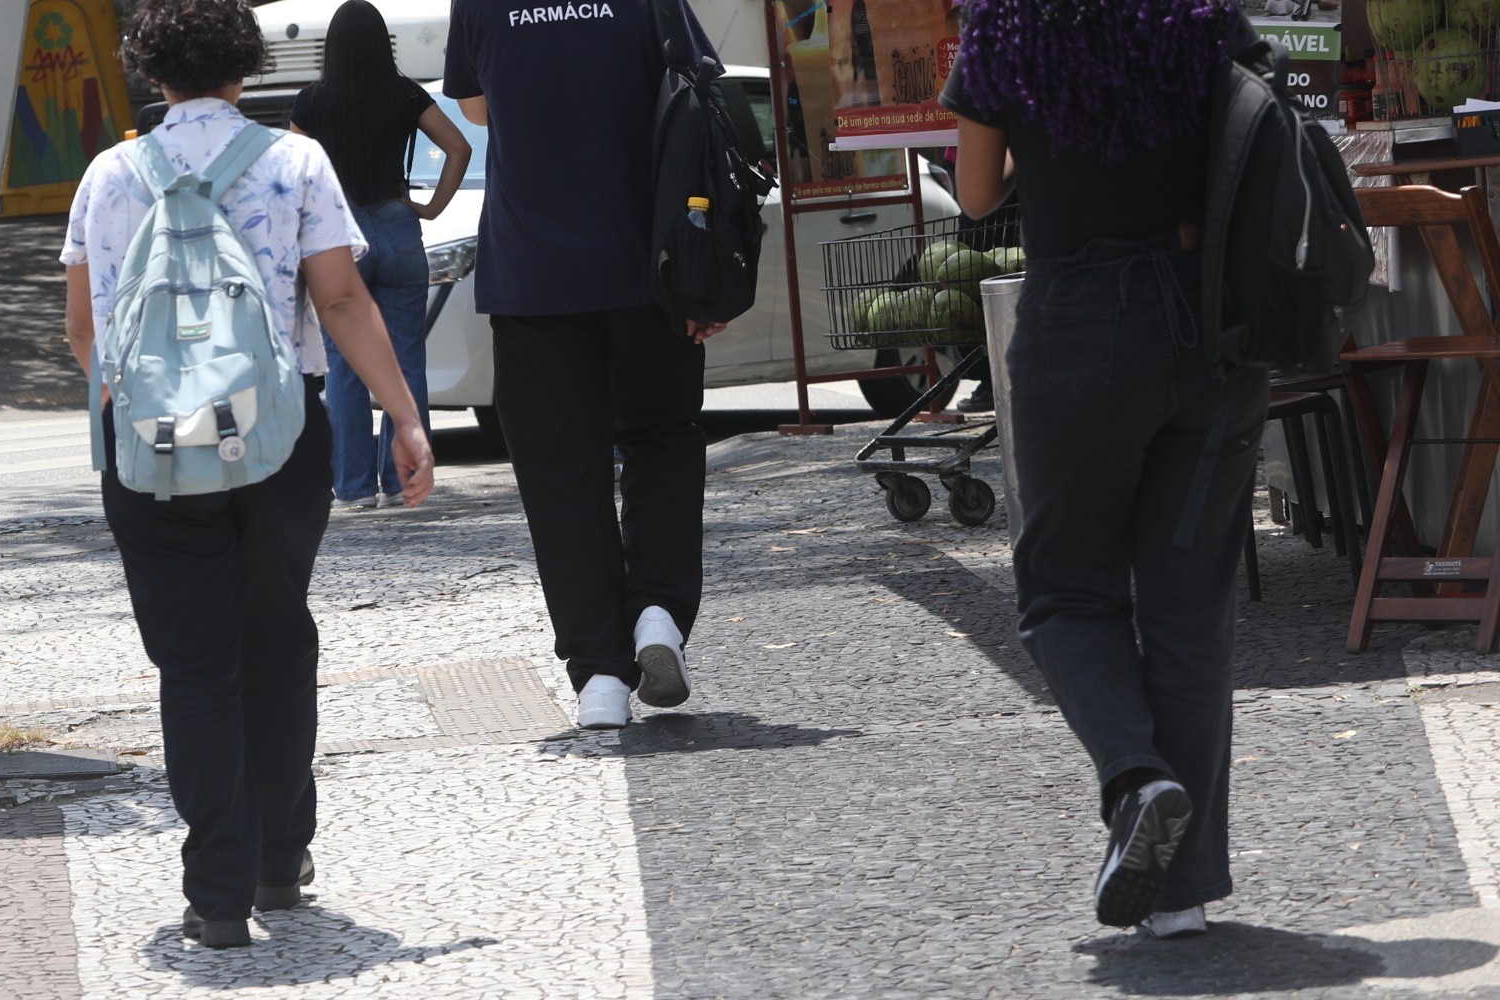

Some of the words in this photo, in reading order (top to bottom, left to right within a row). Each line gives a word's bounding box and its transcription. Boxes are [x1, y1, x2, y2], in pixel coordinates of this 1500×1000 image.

[508, 2, 614, 27] FARMÁCIA
[838, 116, 848, 128] Dê
[850, 116, 862, 126] um
[864, 114, 880, 128] gelo
[881, 116, 890, 126] na
[892, 114, 905, 124] sua
[907, 110, 923, 122] sede
[925, 110, 934, 122] de
